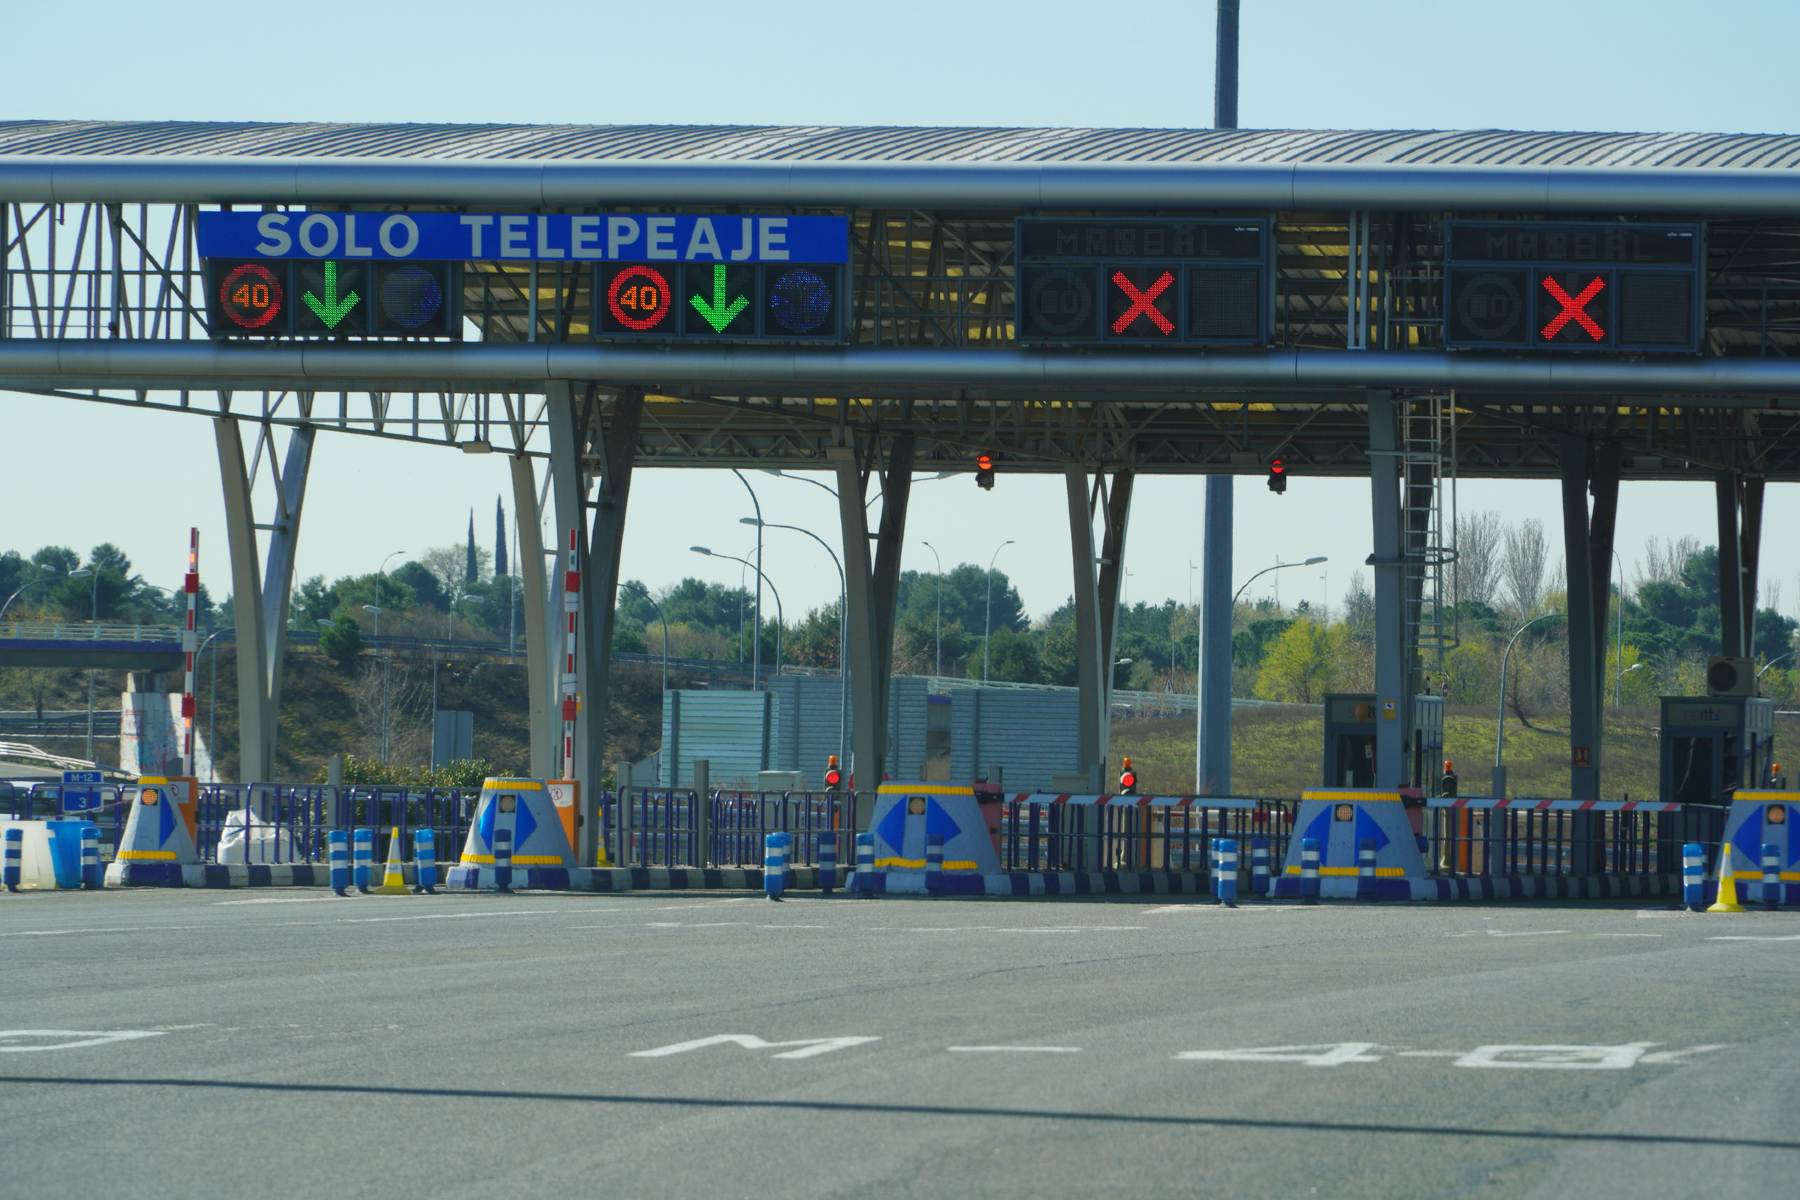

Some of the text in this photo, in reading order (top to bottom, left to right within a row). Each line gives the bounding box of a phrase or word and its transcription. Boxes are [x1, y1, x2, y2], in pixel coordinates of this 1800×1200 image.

[255, 213, 790, 261] SOLO TELEPEAJE
[232, 284, 269, 307] 40
[620, 286, 657, 310] 40
[78, 797, 87, 808] 3
